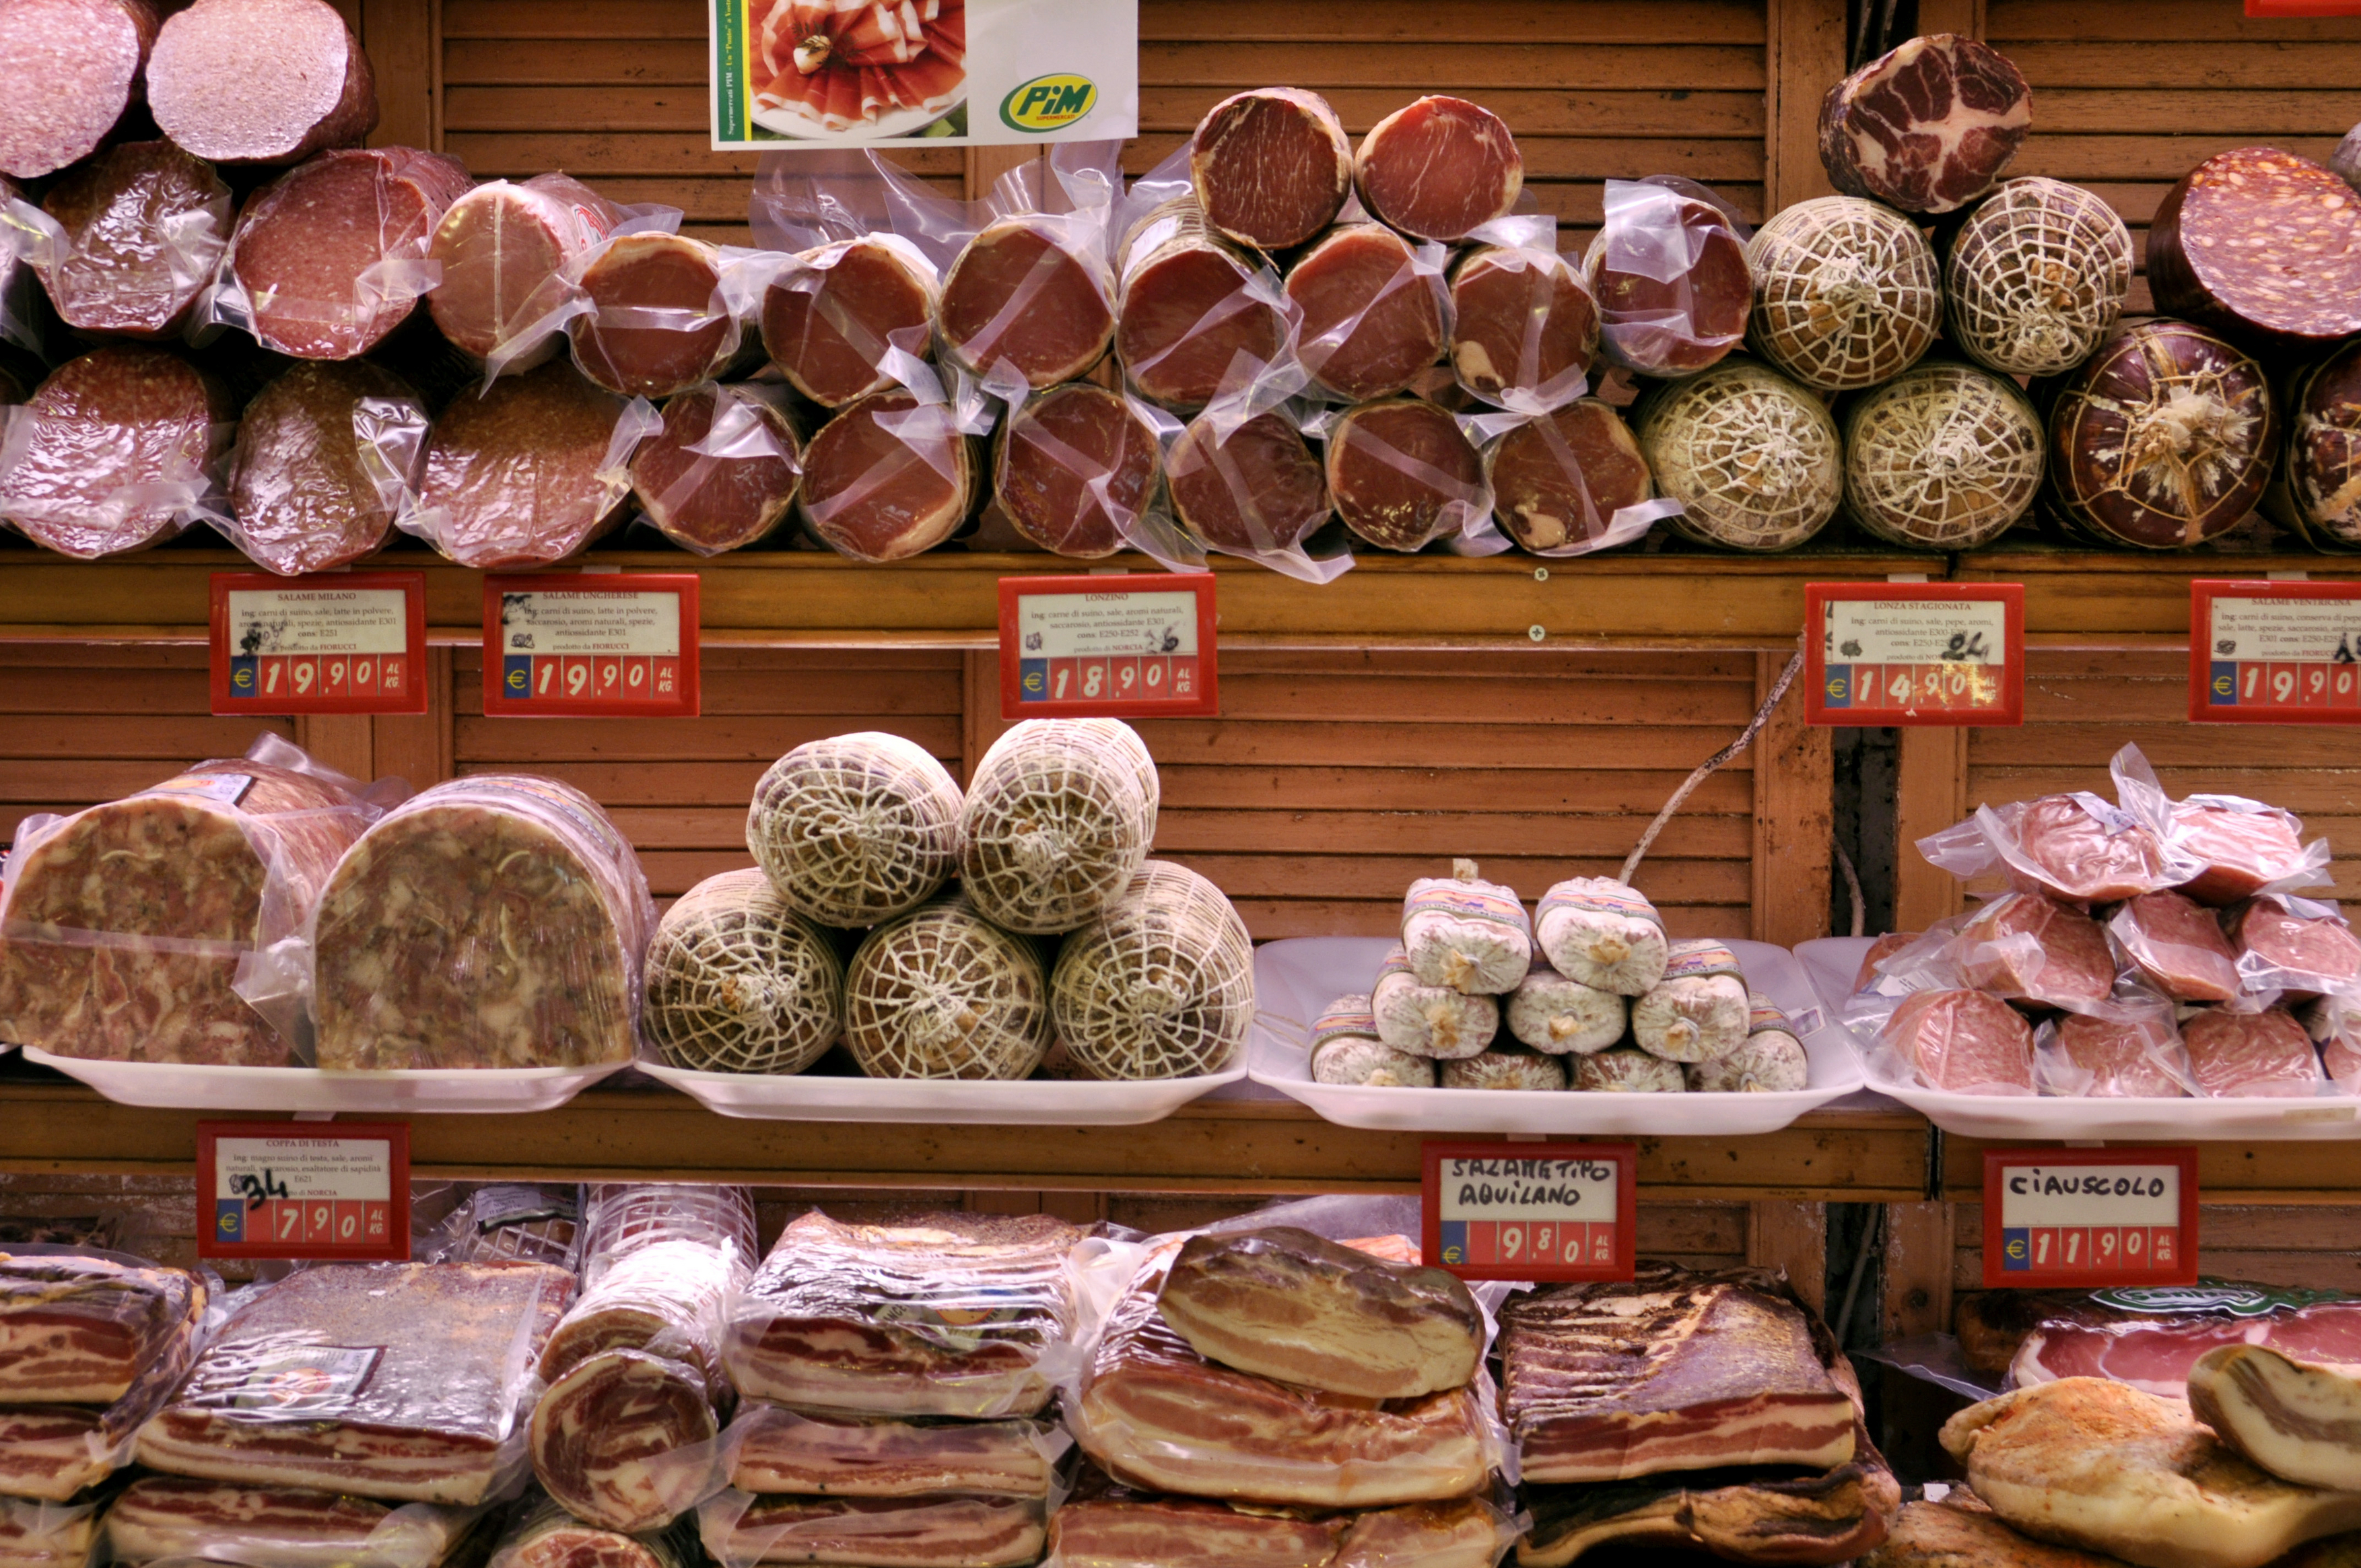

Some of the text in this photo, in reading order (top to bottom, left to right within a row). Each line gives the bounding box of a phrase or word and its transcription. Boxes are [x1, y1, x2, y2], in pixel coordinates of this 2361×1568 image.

[728, 90, 736, 135] Supermercati
[1085, 593, 1128, 601] LONZINO
[626, 607, 658, 616] polvere,
[1909, 602, 1972, 610] STAGIONATA
[386, 663, 399, 674] AL
[659, 667, 673, 679] AL
[1177, 668, 1190, 679] AL
[371, 1210, 383, 1220] AL
[1596, 1235, 1608, 1246] AL
[2158, 1235, 2170, 1246] AL
